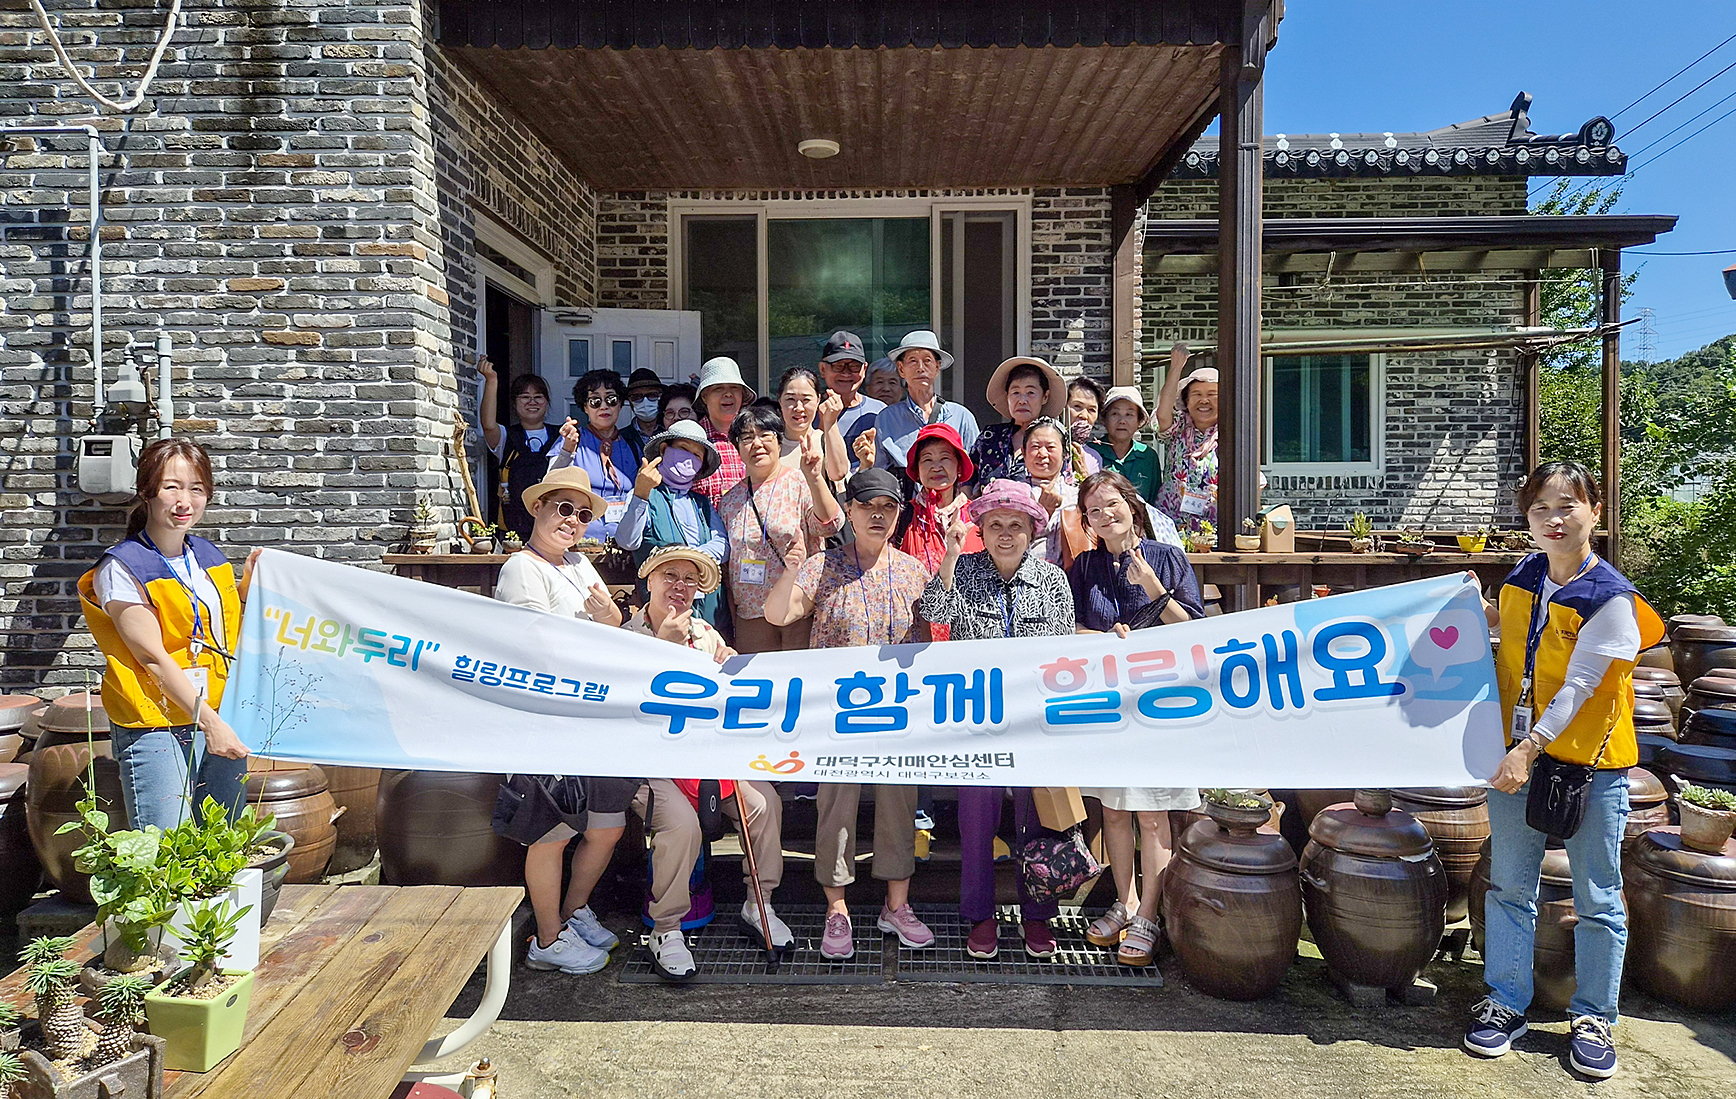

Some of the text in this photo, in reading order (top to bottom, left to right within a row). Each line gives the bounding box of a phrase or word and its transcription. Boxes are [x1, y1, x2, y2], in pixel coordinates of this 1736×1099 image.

[451, 654, 611, 703] 힐링프로그램
[639, 620, 1406, 734] 우리 함께 힐링해요
[813, 769, 991, 780] 대전광역시 대덕구보건소
[815, 752, 1015, 769] 대덕구치매안심센터
